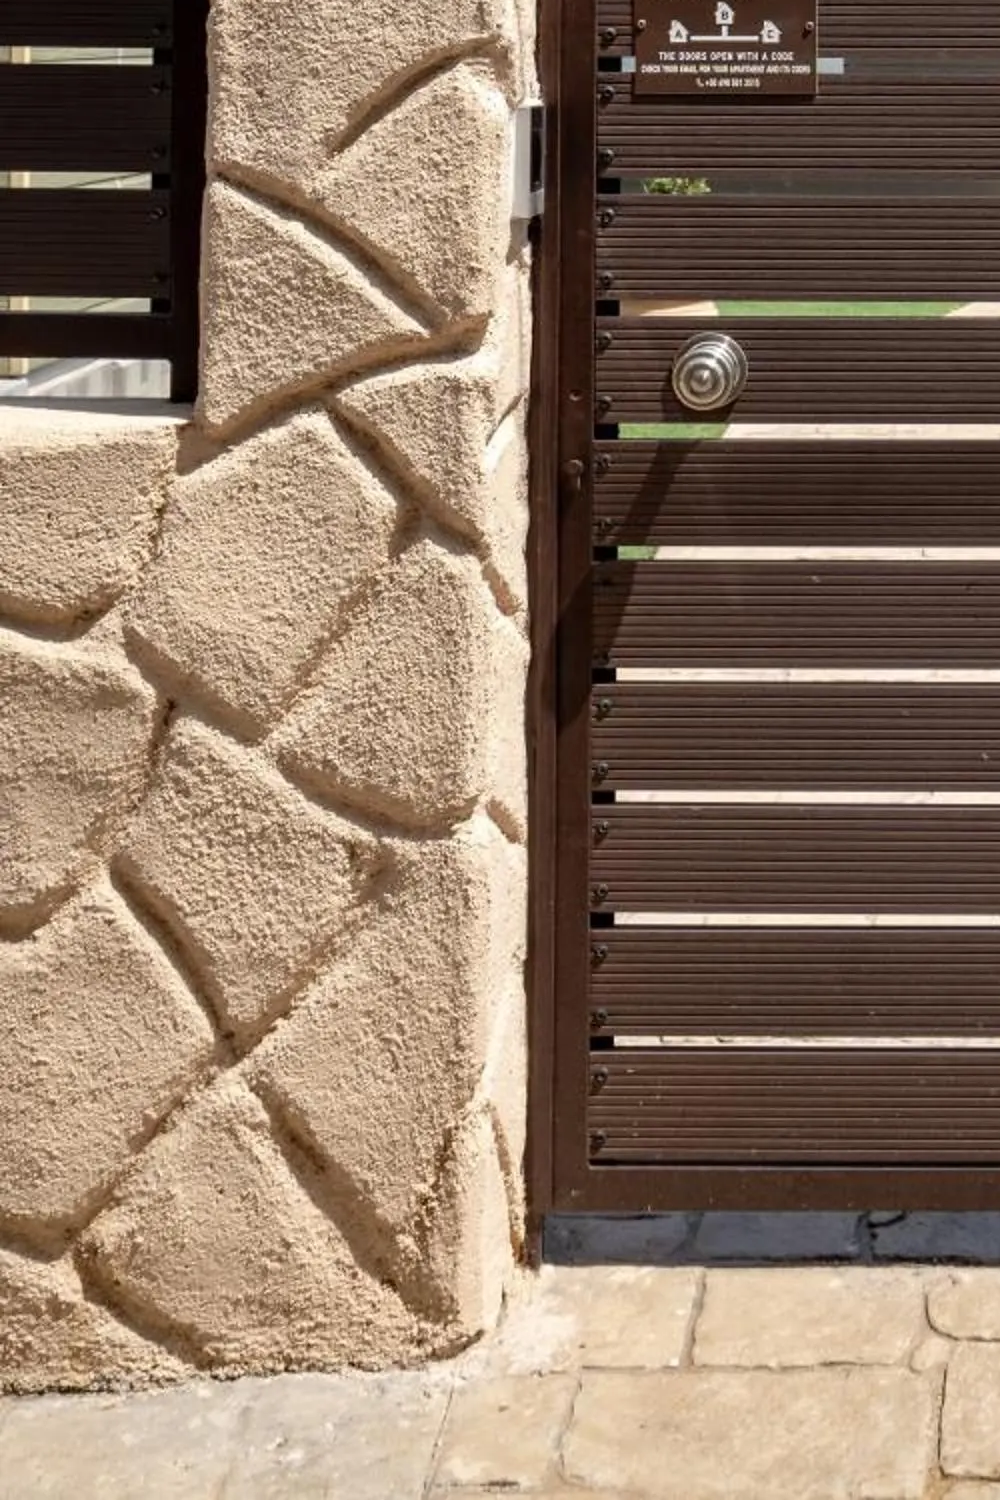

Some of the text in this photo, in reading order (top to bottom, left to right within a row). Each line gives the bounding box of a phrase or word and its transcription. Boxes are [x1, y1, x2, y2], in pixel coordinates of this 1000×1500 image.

[721, 10, 729, 20] B
[675, 29, 683, 39] A
[767, 29, 775, 39] C
[658, 51, 794, 61] THE DOORS OPEN WITH A CODE
